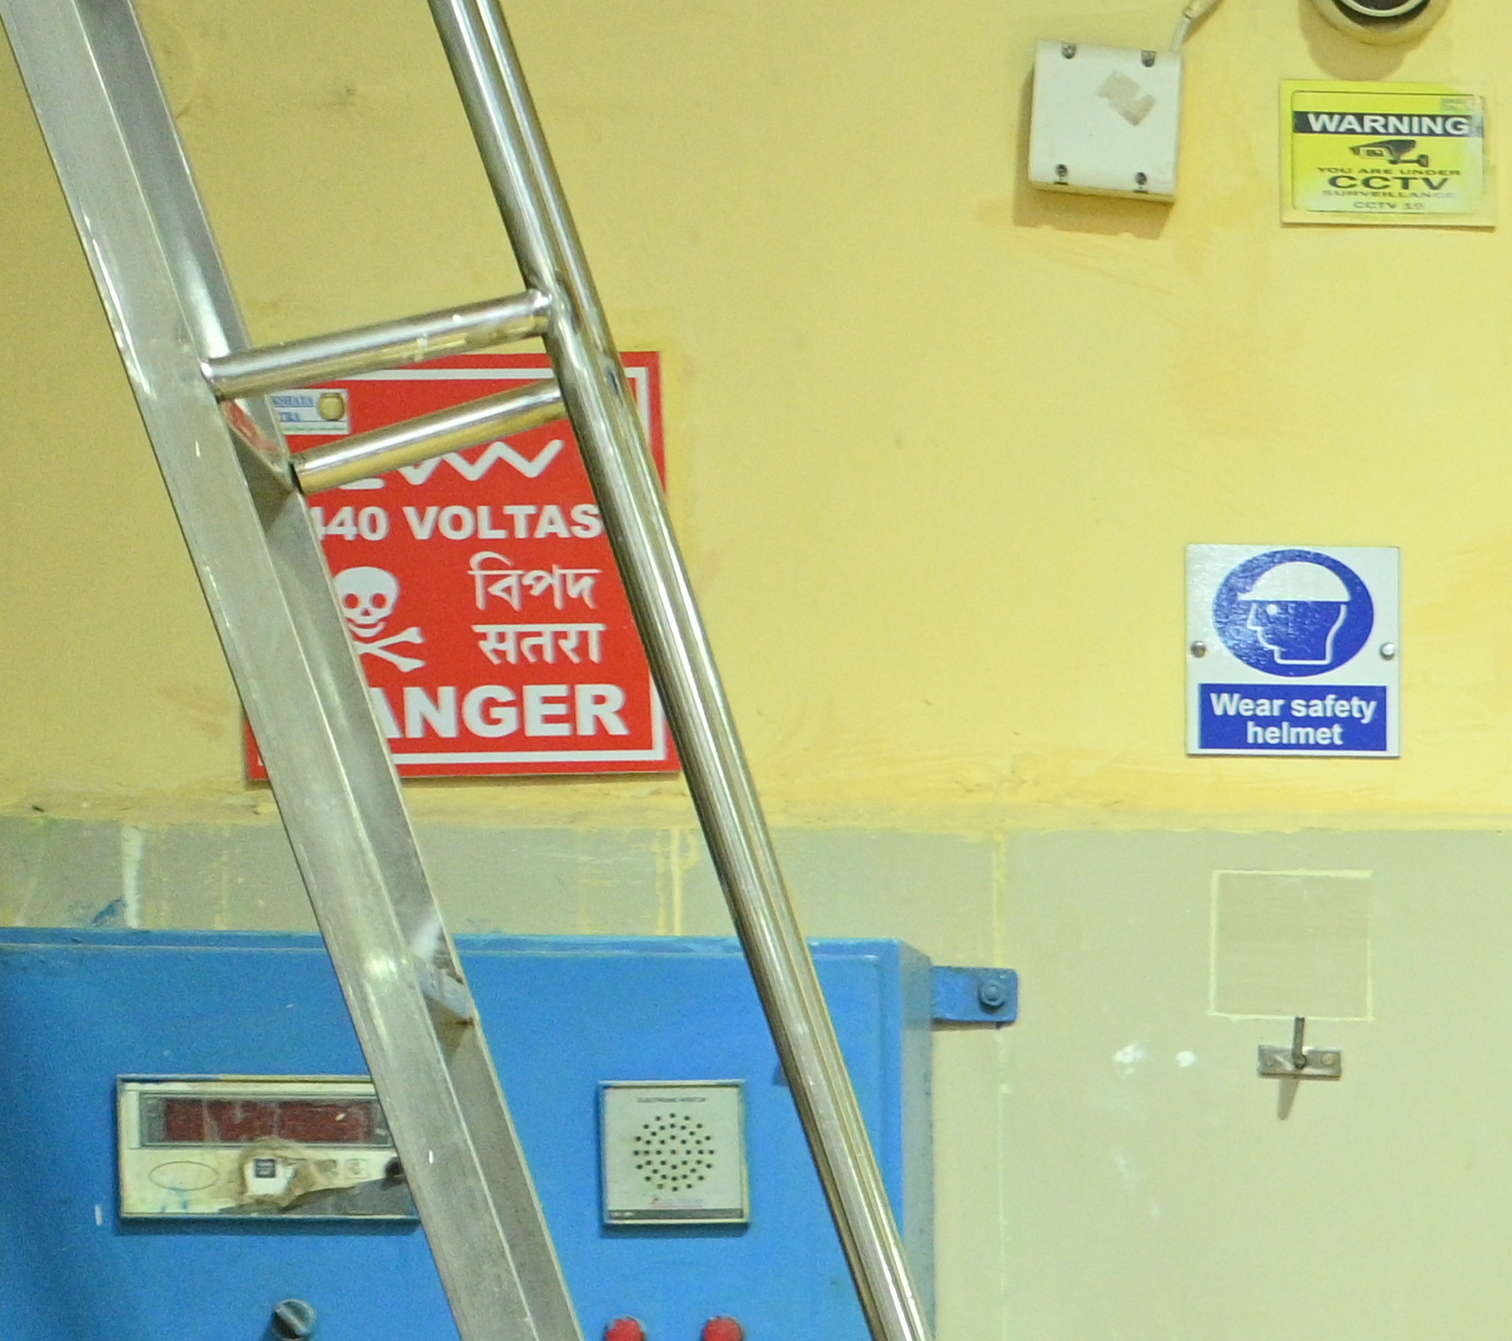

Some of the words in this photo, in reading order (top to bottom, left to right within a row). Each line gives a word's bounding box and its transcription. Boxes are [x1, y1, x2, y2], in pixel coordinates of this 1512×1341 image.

[1307, 113, 1471, 136] WARNING
[1317, 167, 1353, 175] YOU
[1357, 167, 1394, 175] ARE
[1398, 168, 1462, 176] UNDER
[1327, 175, 1450, 191] CCTV
[1321, 189, 1457, 199] SURVEILLANCE
[1352, 201, 1396, 210] CCTV
[403, 503, 604, 541] VOLTAS
[467, 551, 602, 611] বিপদ
[370, 683, 630, 738] ANGER
[1210, 693, 1286, 716] Wear
[1291, 694, 1377, 725] safety
[1246, 721, 1344, 745] helmet
